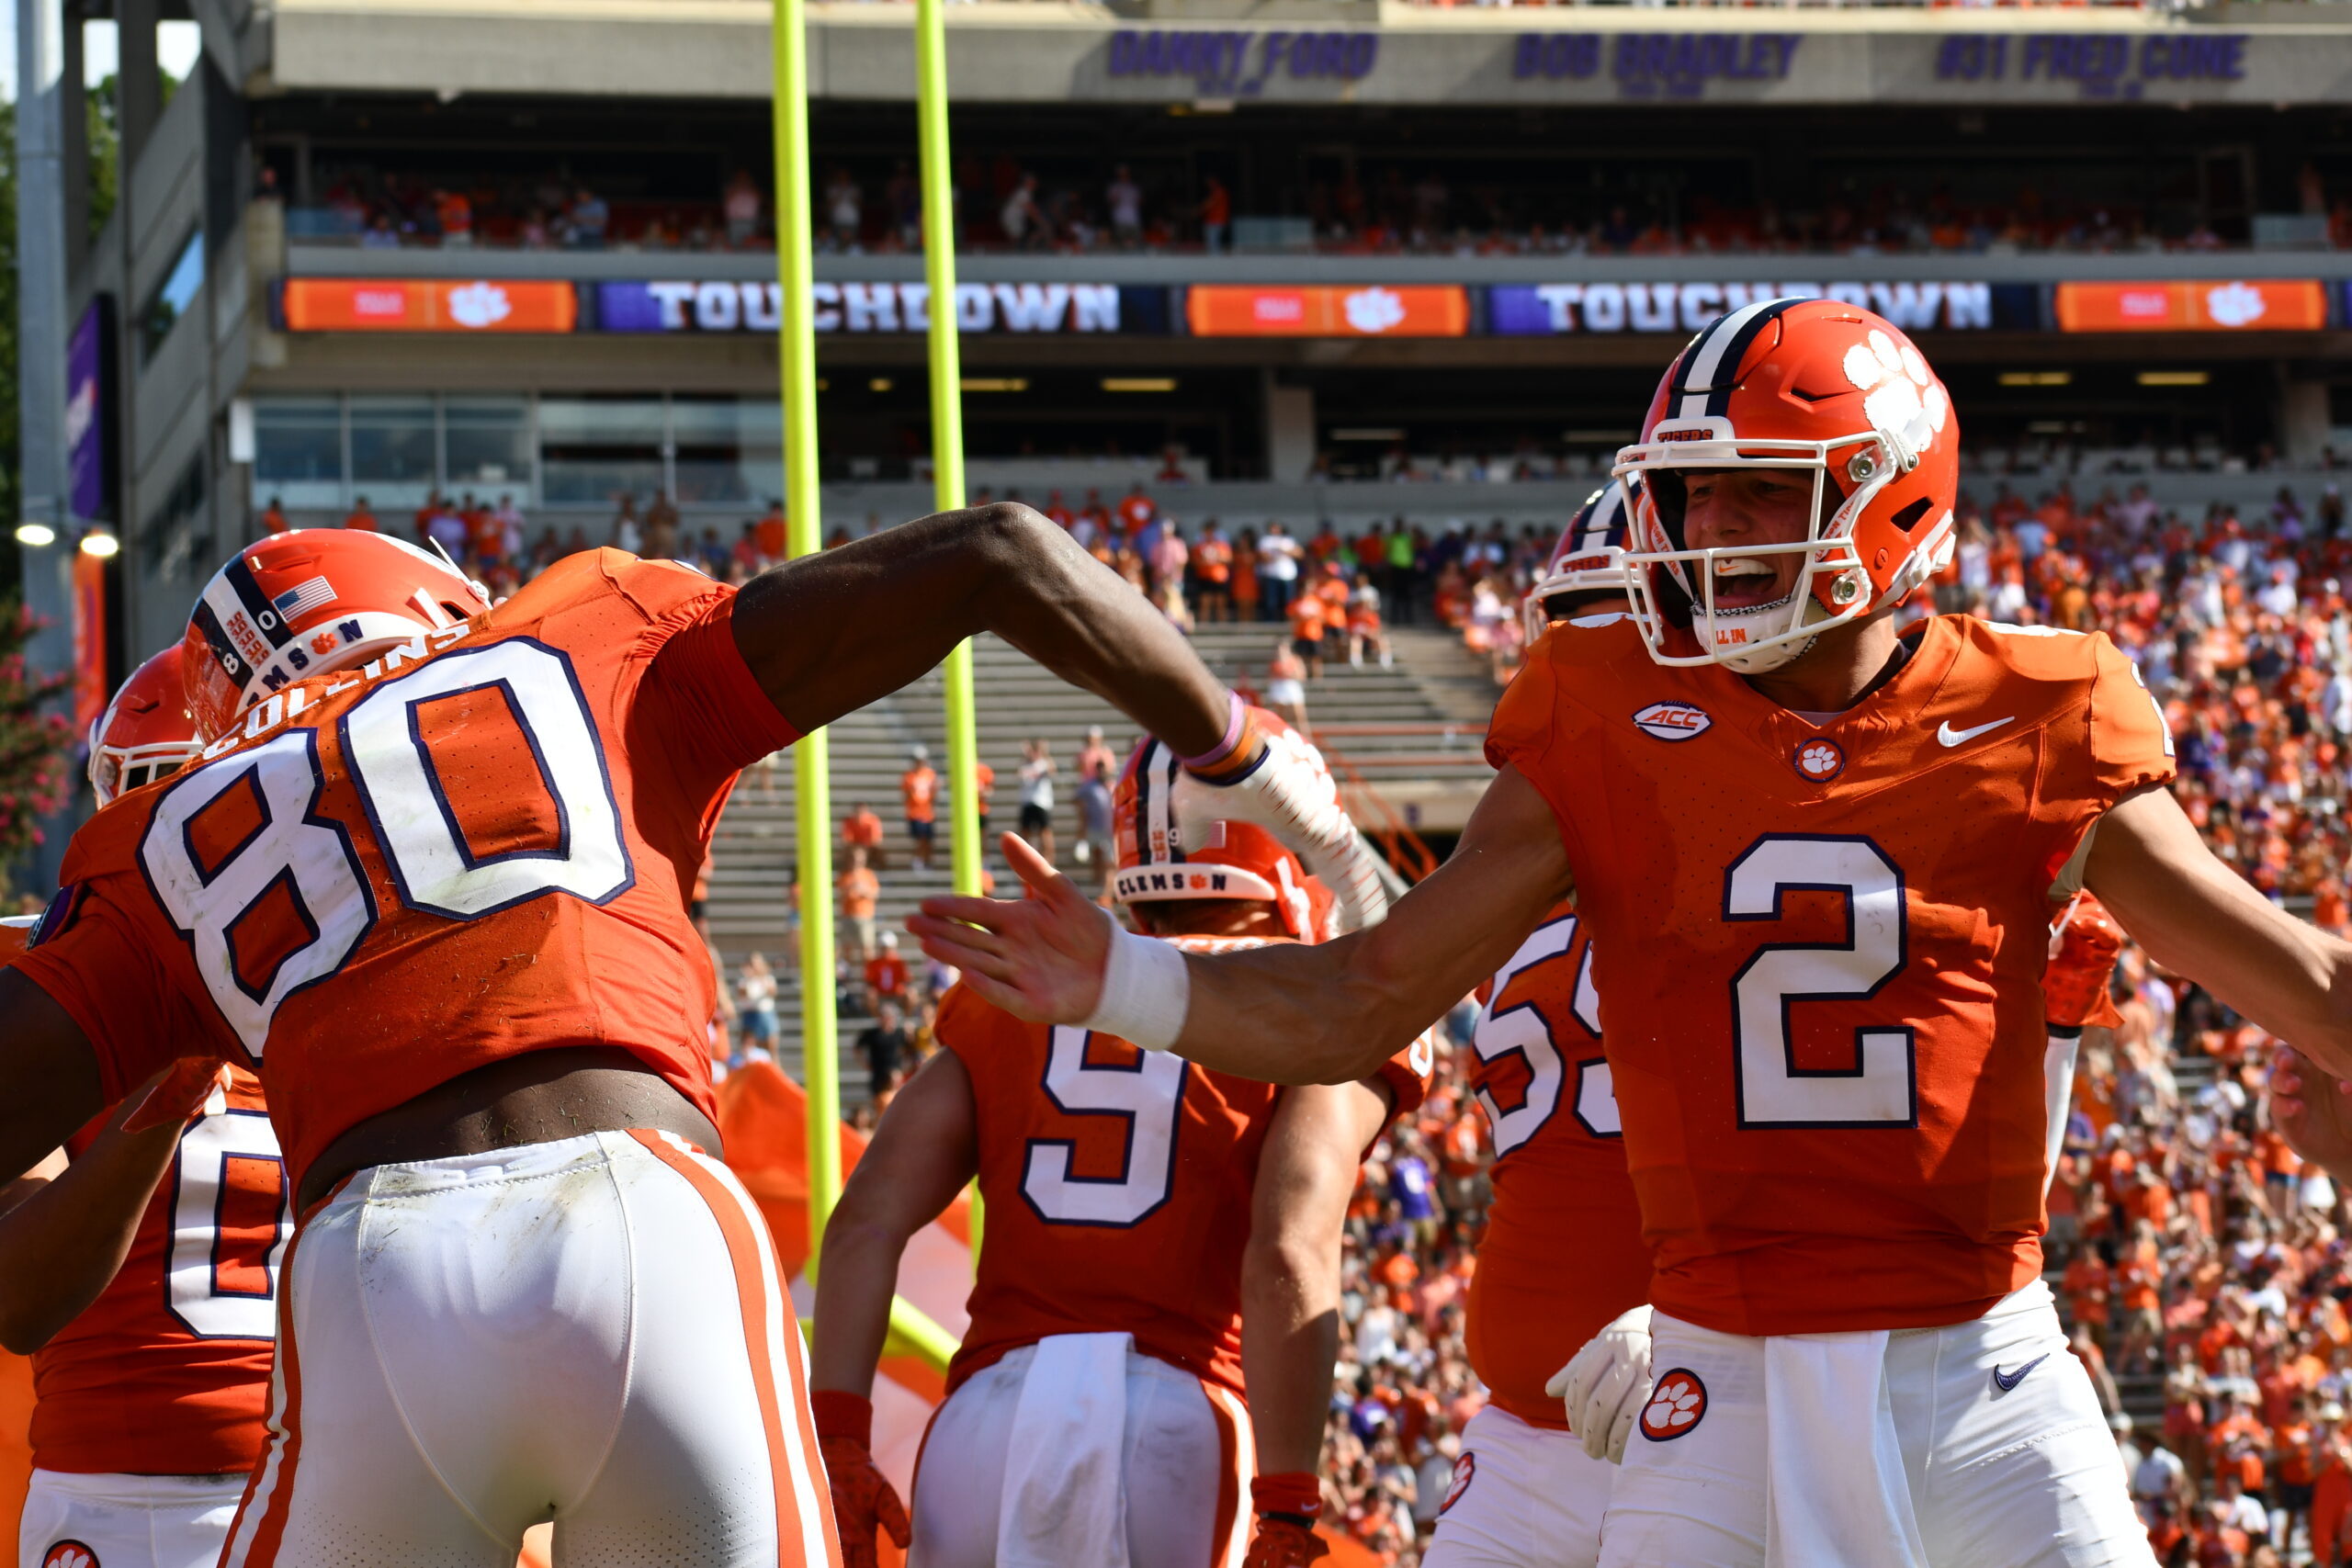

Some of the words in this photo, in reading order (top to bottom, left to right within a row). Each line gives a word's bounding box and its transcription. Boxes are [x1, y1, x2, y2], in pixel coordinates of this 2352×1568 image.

[1108, 31, 1254, 77] DANNY
[1261, 32, 1377, 77] FORD
[1514, 34, 1600, 79] BOB
[1616, 34, 1804, 79] BRADLEY
[2023, 35, 2131, 79] FRED
[2141, 35, 2249, 79] CONE
[647, 281, 1119, 331] TOUCHDOWN
[1538, 283, 1991, 331] TOUCWN
[1657, 429, 1713, 443] TIGERS
[1731, 628, 1747, 644] IN
[223, 652, 240, 675] 8
[1643, 709, 1705, 727] ACC
[136, 636, 636, 1067] 80
[1169, 828, 1182, 848] 9
[1722, 832, 1917, 1130] 2
[1018, 1024, 1190, 1229] 9
